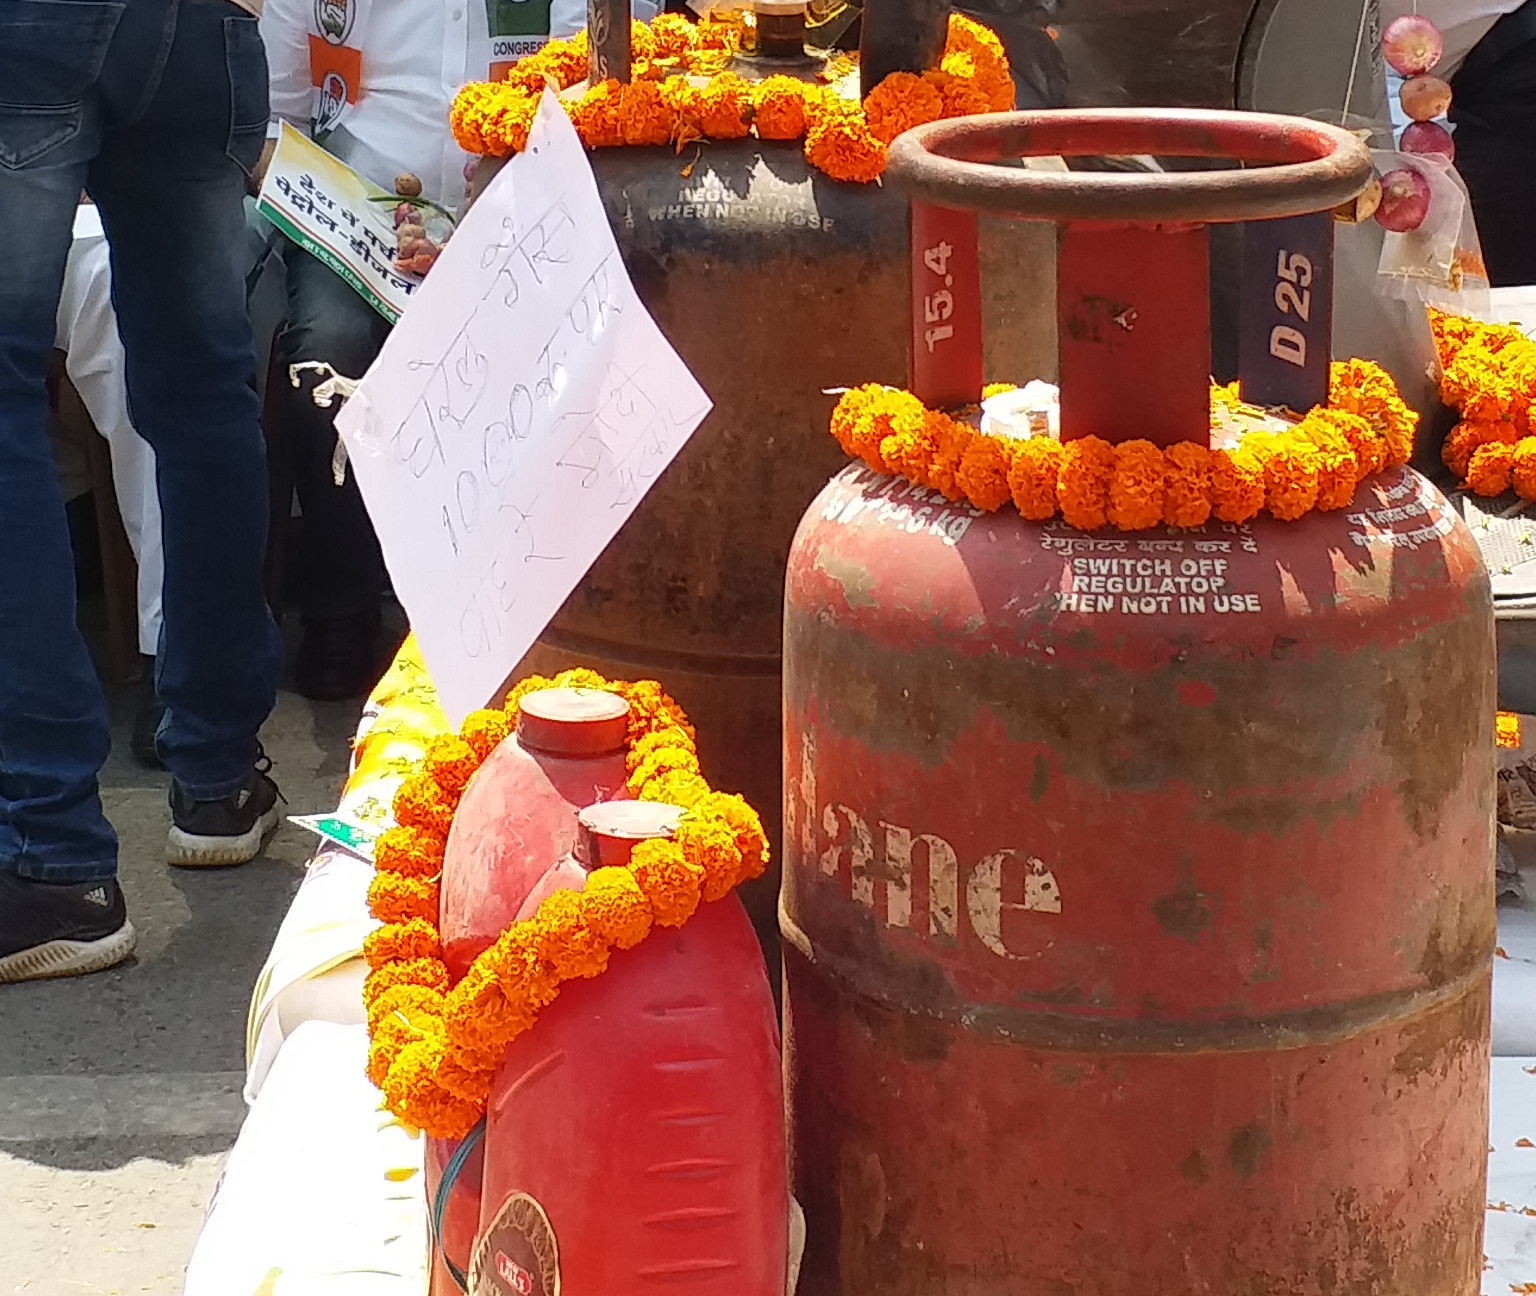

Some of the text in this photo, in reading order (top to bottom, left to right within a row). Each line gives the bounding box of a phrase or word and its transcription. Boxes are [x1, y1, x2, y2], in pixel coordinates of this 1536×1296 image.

[1272, 250, 1314, 322] 25
[923, 240, 954, 353] 15.4
[1193, 539, 1232, 553] कर
[1073, 557, 1228, 577] SWITCH OFF
[1121, 596, 1173, 615] NOT
[1180, 596, 1206, 615] IN
[1214, 595, 1263, 614] USE
